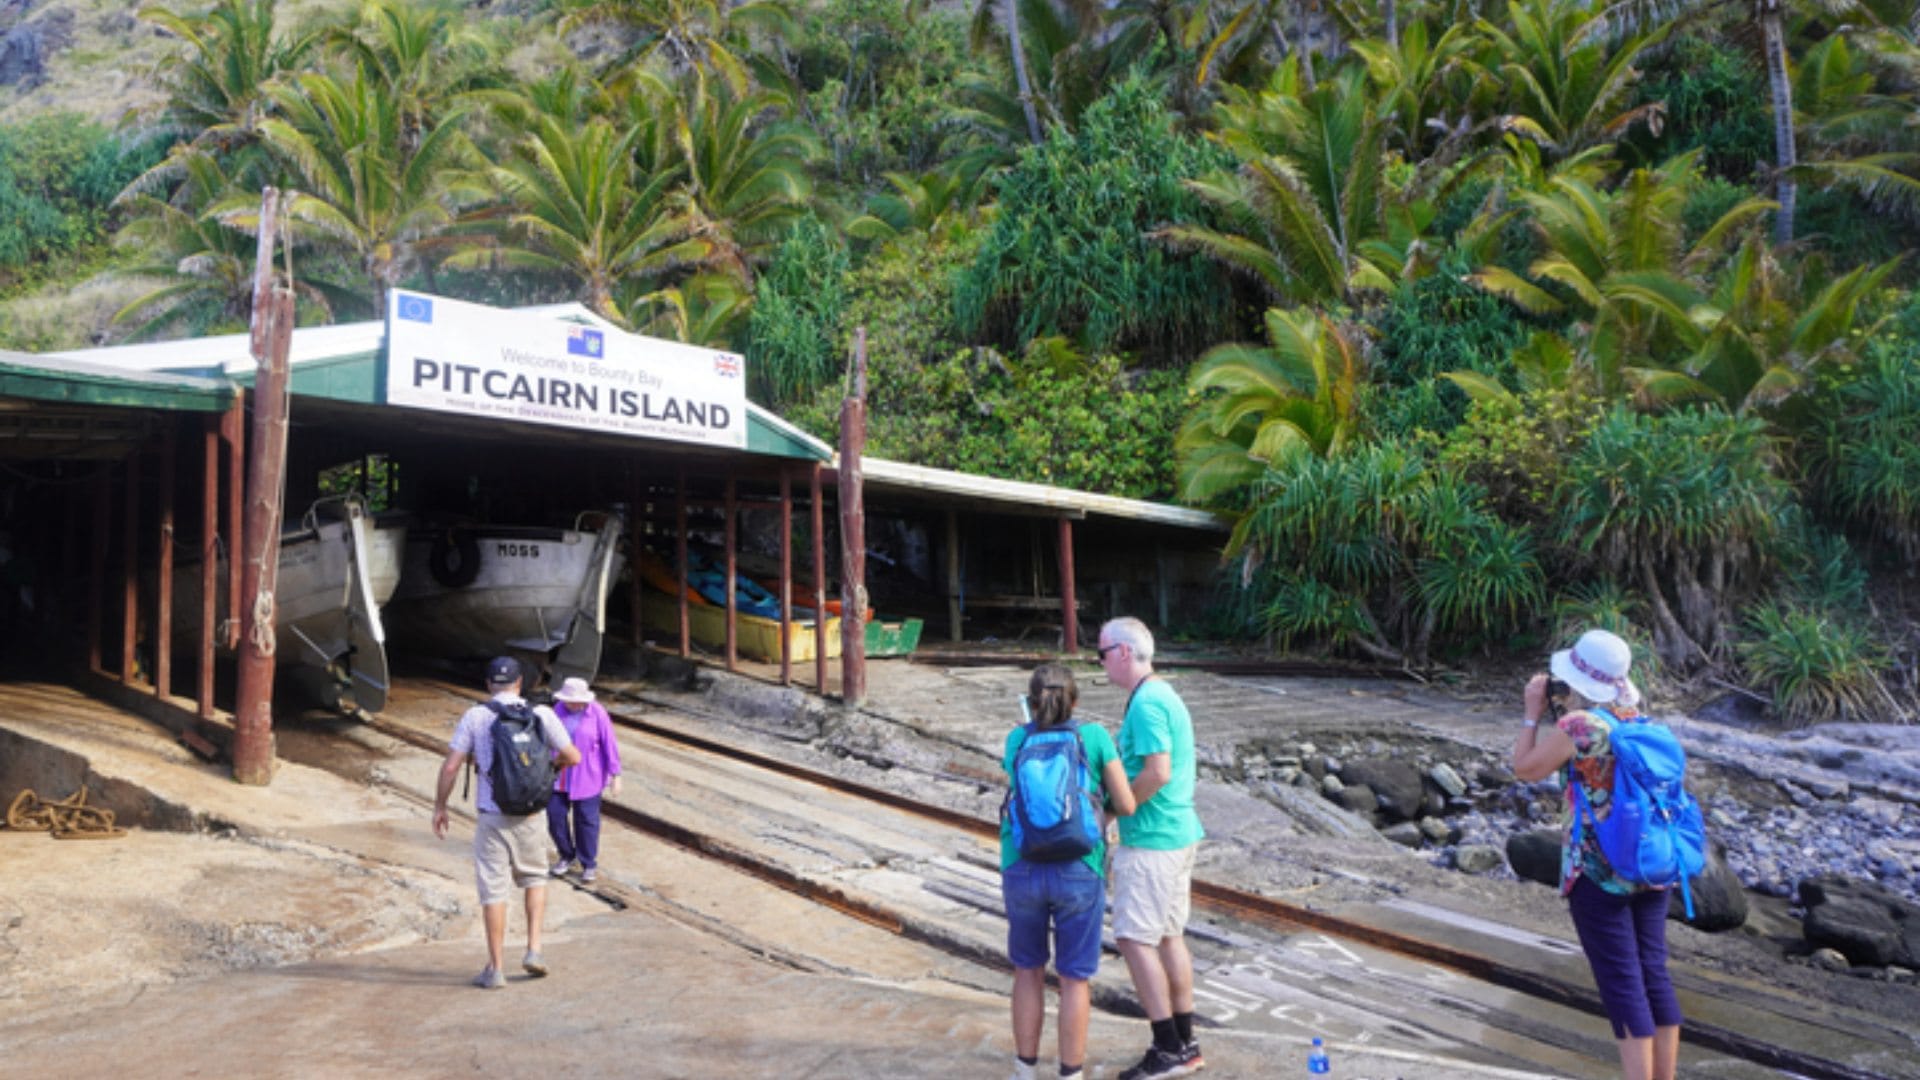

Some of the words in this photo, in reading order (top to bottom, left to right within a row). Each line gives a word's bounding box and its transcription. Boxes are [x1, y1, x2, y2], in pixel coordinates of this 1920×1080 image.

[501, 346, 567, 371] Welcome
[572, 360, 585, 374] to
[589, 362, 634, 384] Bounty
[639, 369, 663, 389] Bay
[413, 357, 598, 412] PITCAIRN
[610, 388, 730, 430] ISLAND
[498, 544, 539, 558] MOSS
